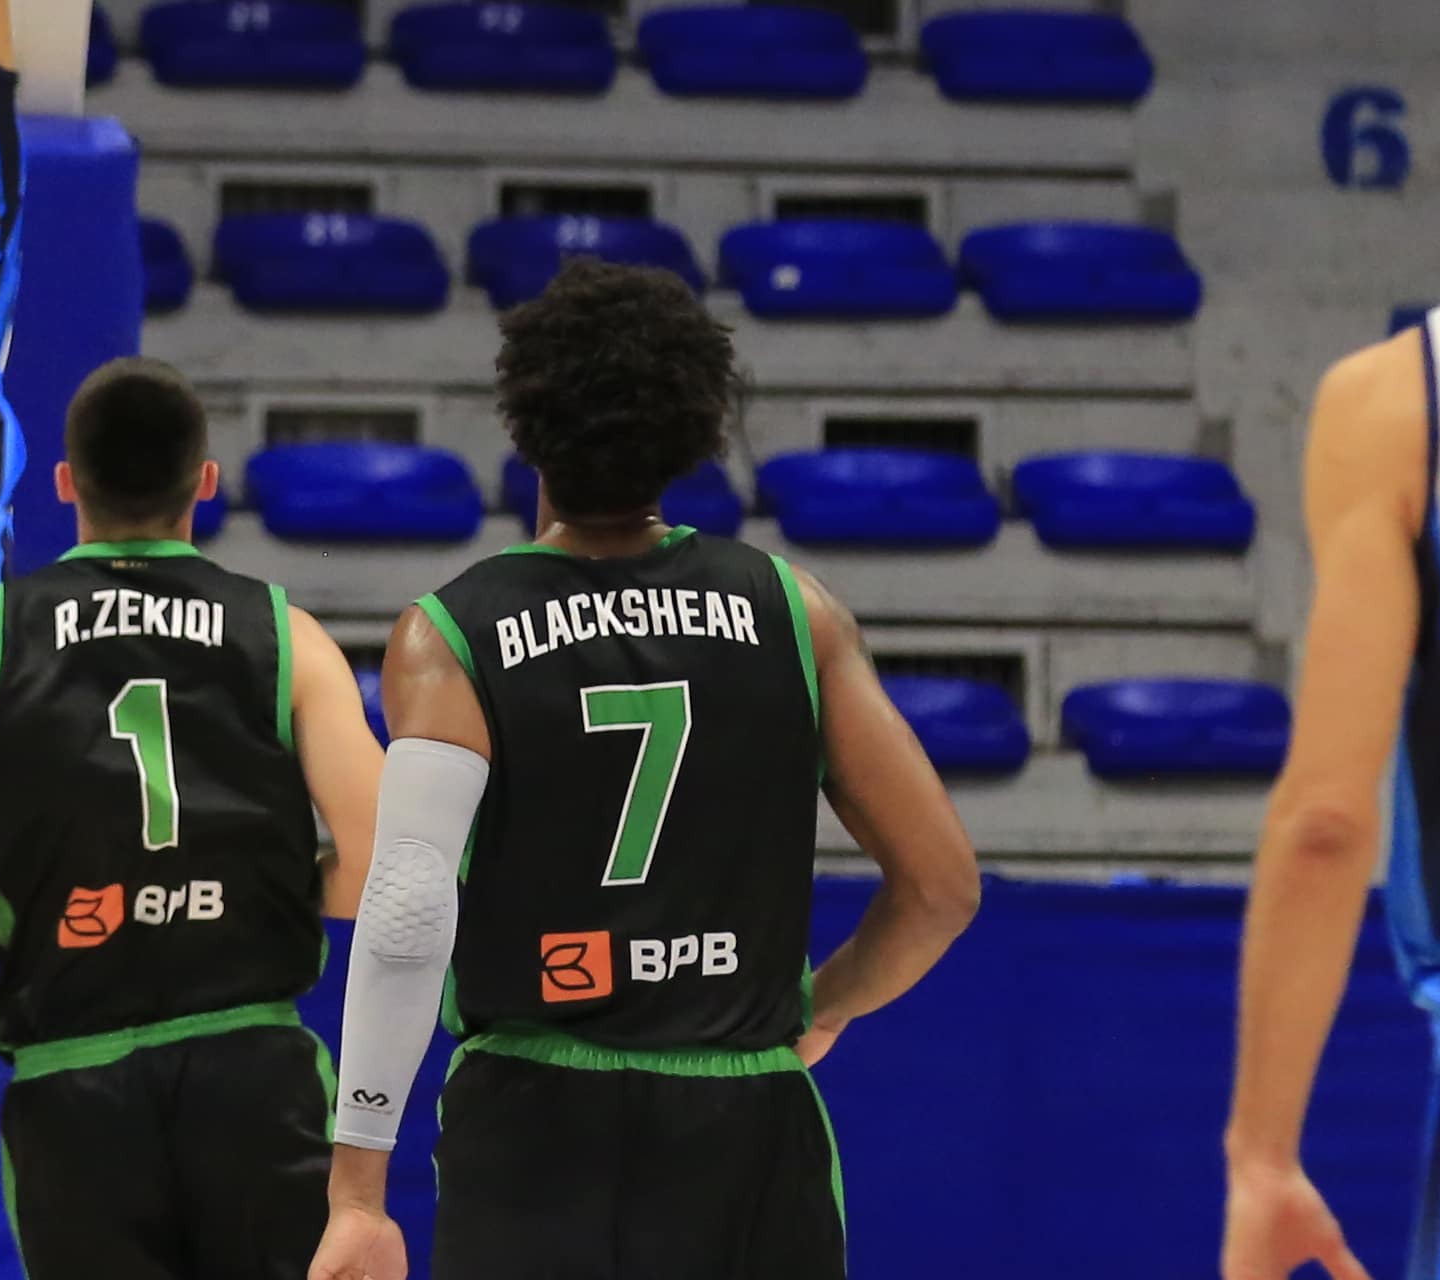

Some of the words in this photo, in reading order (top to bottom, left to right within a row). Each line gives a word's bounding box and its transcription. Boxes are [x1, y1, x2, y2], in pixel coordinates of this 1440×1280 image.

[1320, 85, 1411, 192] 6
[54, 588, 225, 650] R.ZEKIQI
[495, 587, 761, 670] BLACKSHEAR
[108, 678, 180, 851] 1
[580, 680, 693, 887] 7
[133, 880, 225, 925] BPB
[629, 931, 740, 983] BPB
